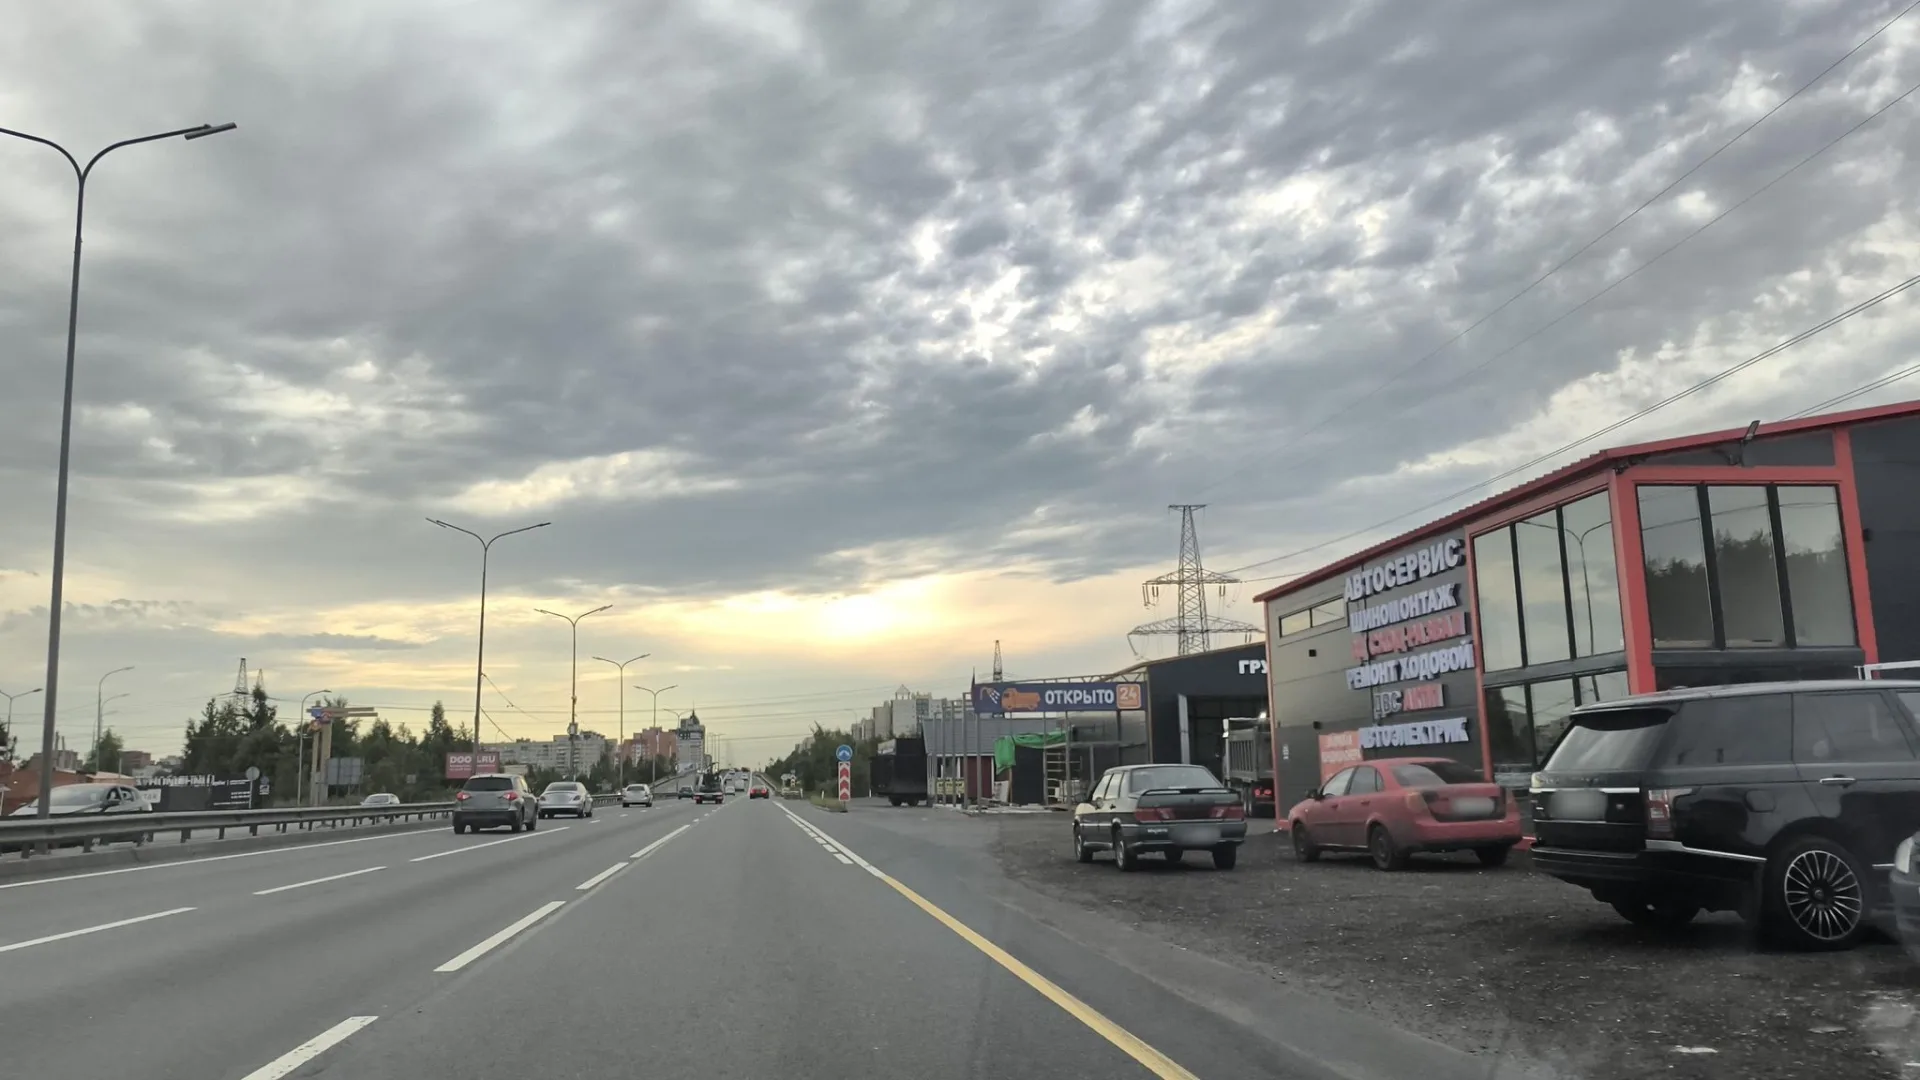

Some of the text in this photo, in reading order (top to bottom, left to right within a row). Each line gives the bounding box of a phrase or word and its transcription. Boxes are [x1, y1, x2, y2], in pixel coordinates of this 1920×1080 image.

[1344, 538, 1460, 602] АВТОСЕРВИС
[1350, 583, 1458, 633] ШИНОМОНТАЖ
[1345, 638, 1475, 690] РЕМОНТ ХОДОВОЙ
[1045, 686, 1138, 705] ОТКРЫТО 24
[1373, 690, 1402, 719] ДВС
[1358, 716, 1469, 749] АВТОЭЛЕКТРИК
